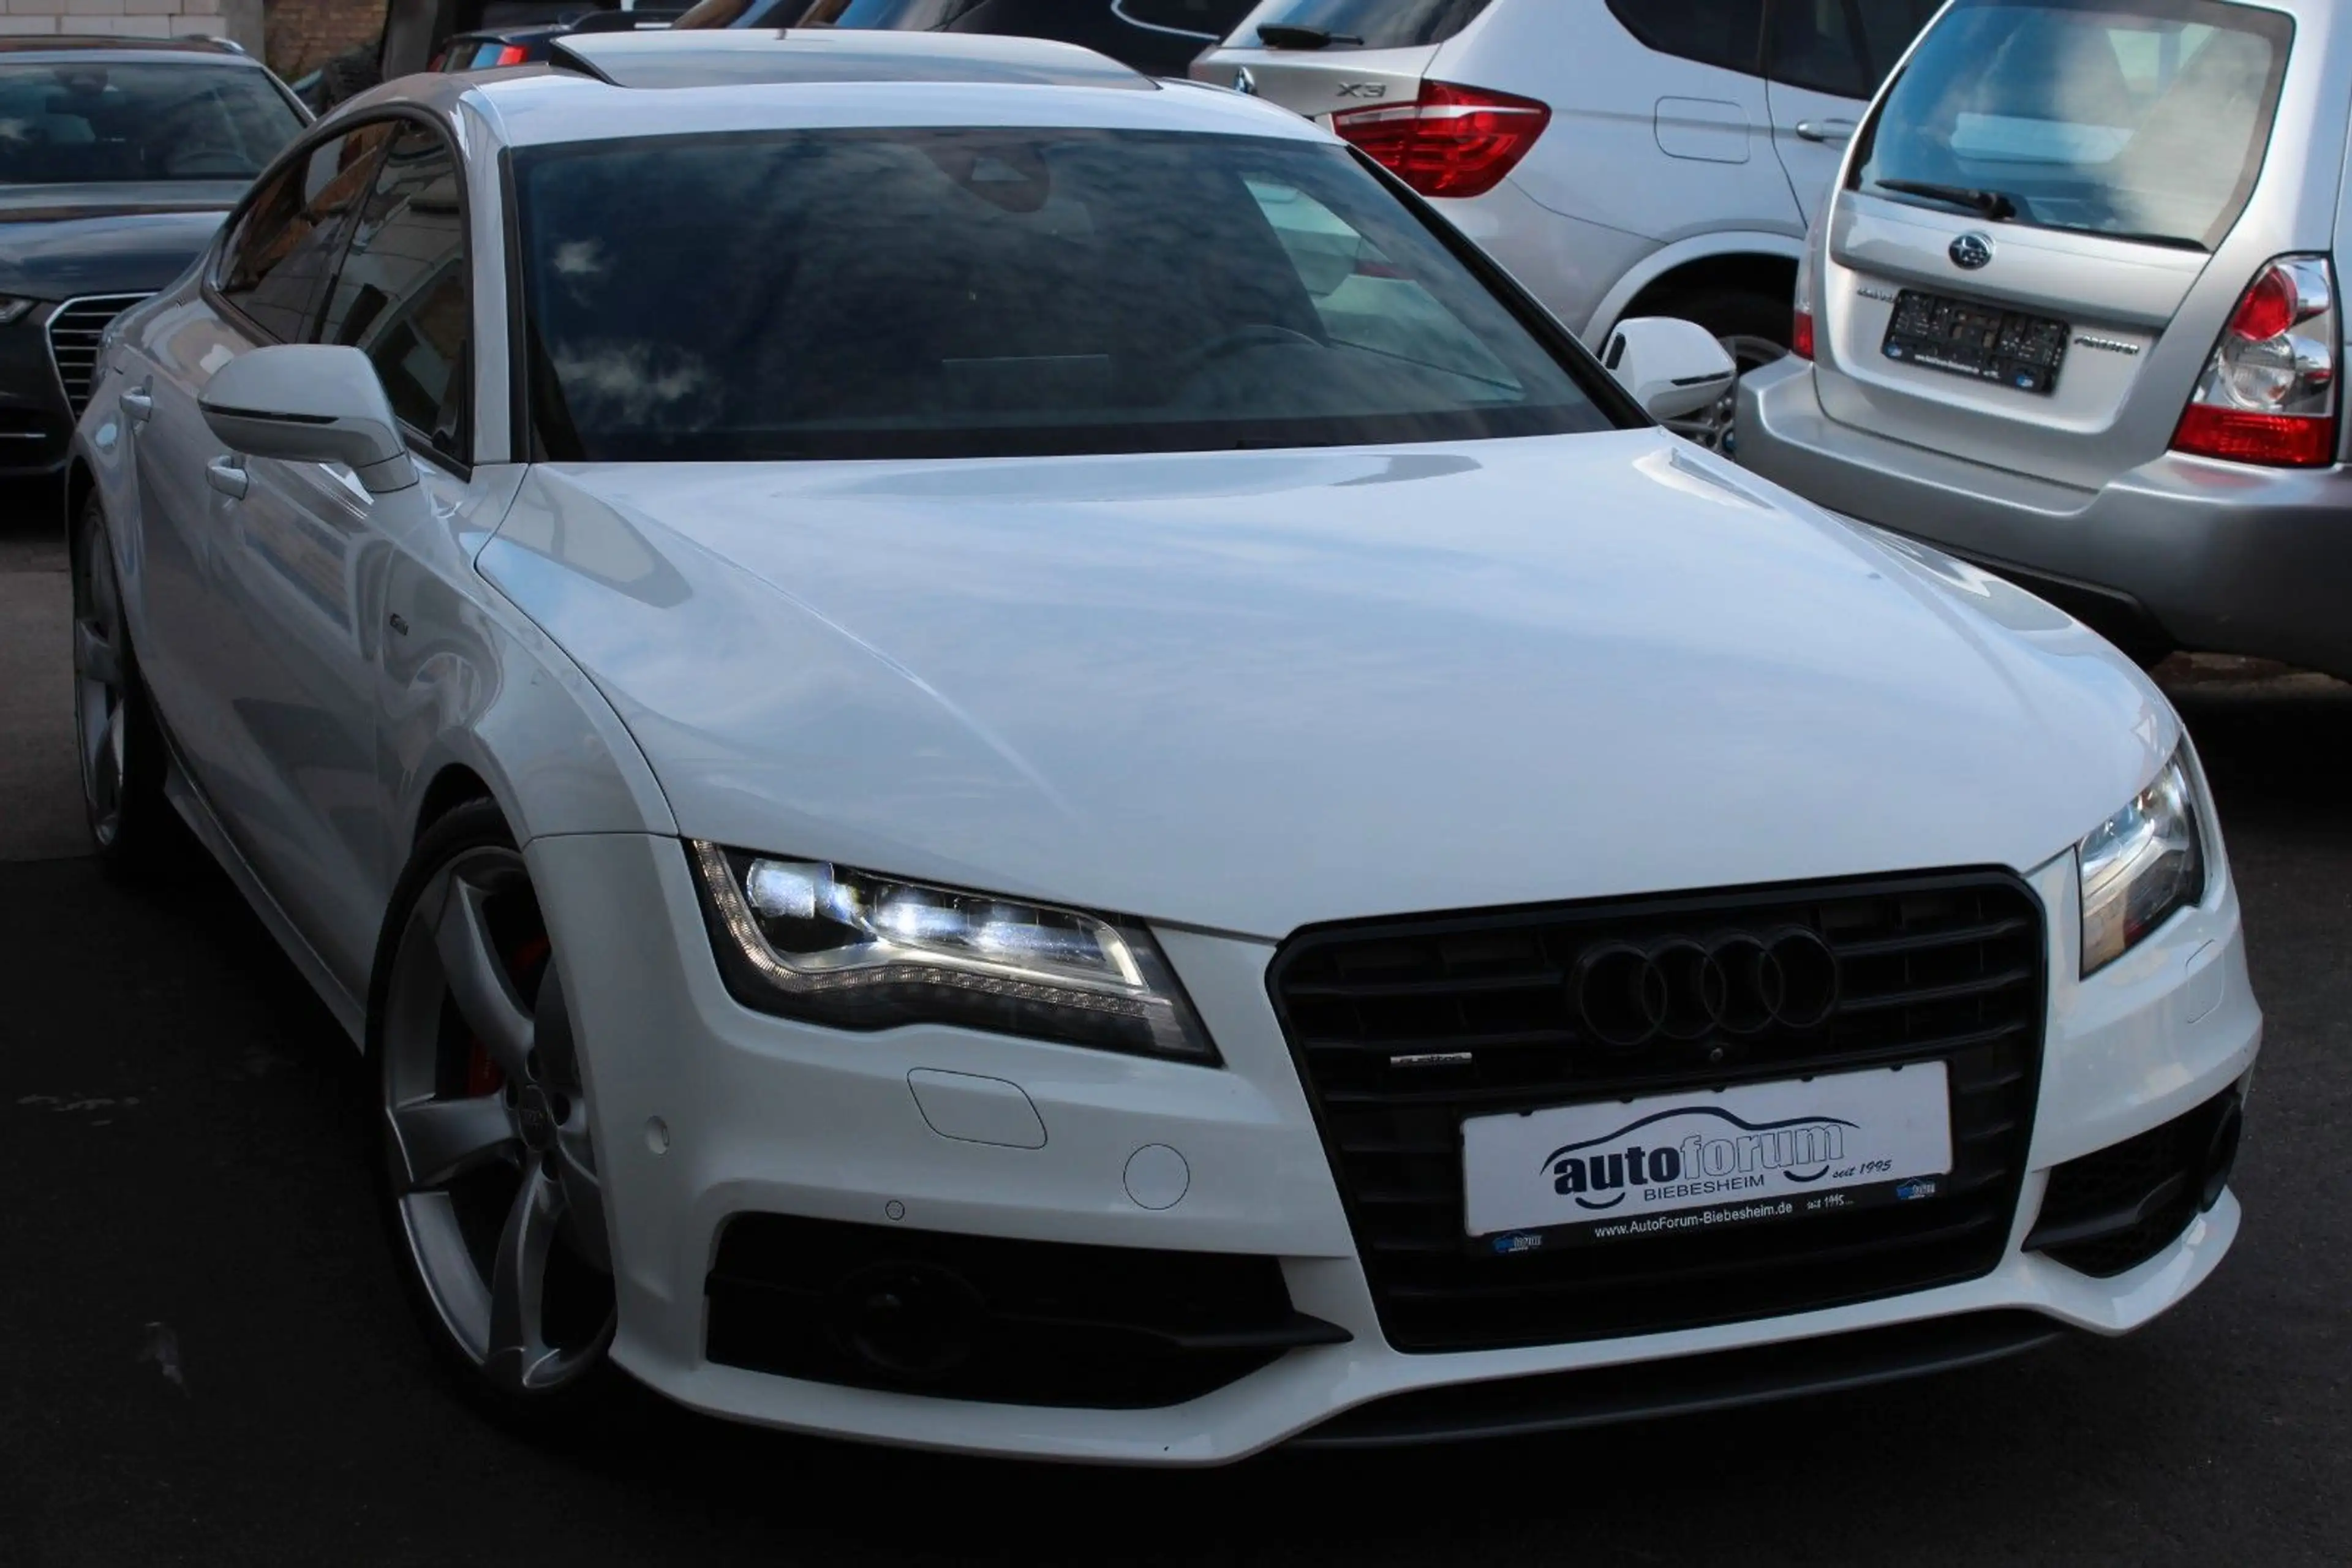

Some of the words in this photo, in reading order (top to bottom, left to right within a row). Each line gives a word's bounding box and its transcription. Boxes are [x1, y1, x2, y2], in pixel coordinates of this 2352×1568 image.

[1336, 82, 1386, 98] X3
[1832, 1166, 1856, 1178] seit
[1860, 1159, 1892, 1174] 1995
[1644, 1174, 1765, 1202] BIEBESHEIM
[1594, 1200, 1793, 1238] www.AutoForum-Biebesheim.de
